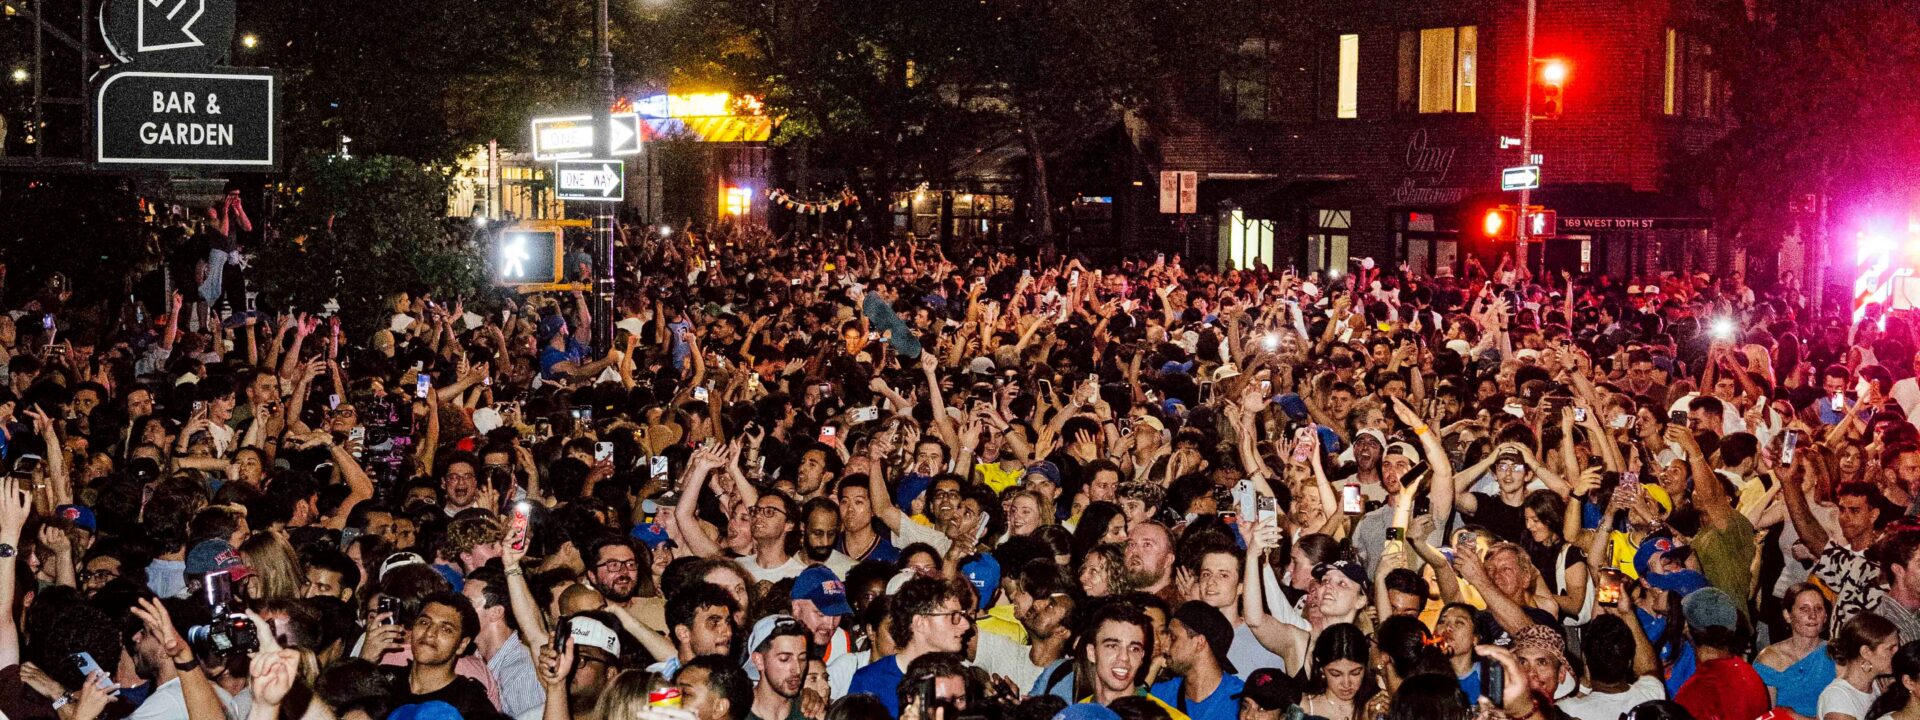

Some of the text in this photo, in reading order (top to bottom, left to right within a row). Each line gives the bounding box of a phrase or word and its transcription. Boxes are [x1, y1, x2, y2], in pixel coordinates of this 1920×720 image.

[153, 91, 221, 115] BAR &
[139, 121, 234, 146] GARDEN
[550, 130, 578, 147] ONE
[566, 172, 613, 188] ONE WAY
[1564, 218, 1654, 228] 169 WEST 10TH ST
